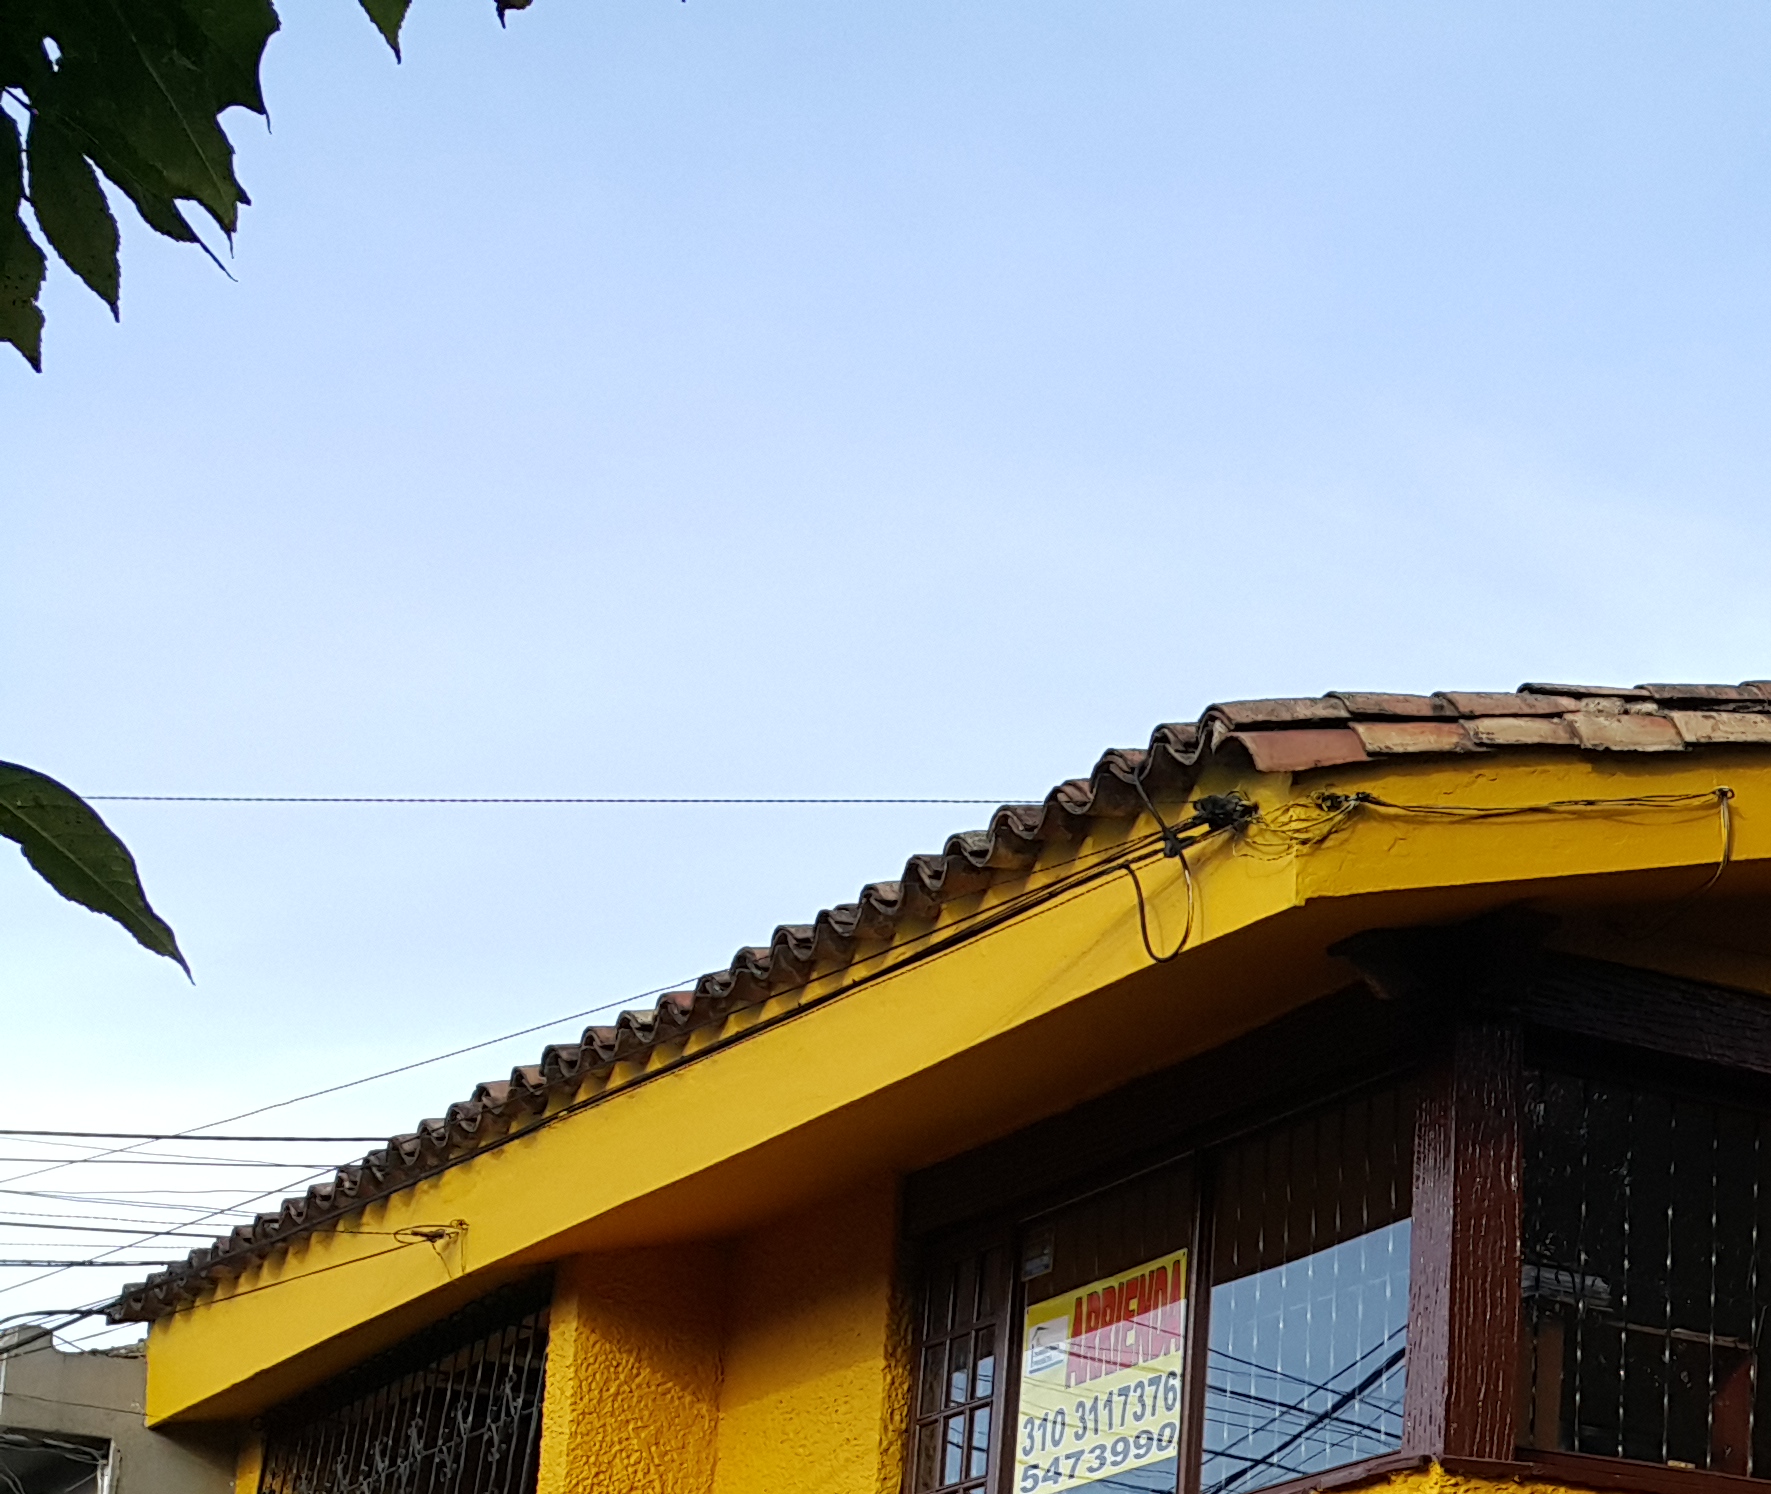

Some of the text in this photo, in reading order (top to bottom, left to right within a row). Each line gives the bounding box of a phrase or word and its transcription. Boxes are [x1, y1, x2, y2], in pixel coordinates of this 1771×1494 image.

[1065, 1260, 1181, 1388] ARRIENDA
[1022, 1371, 1179, 1457] 310 3117376
